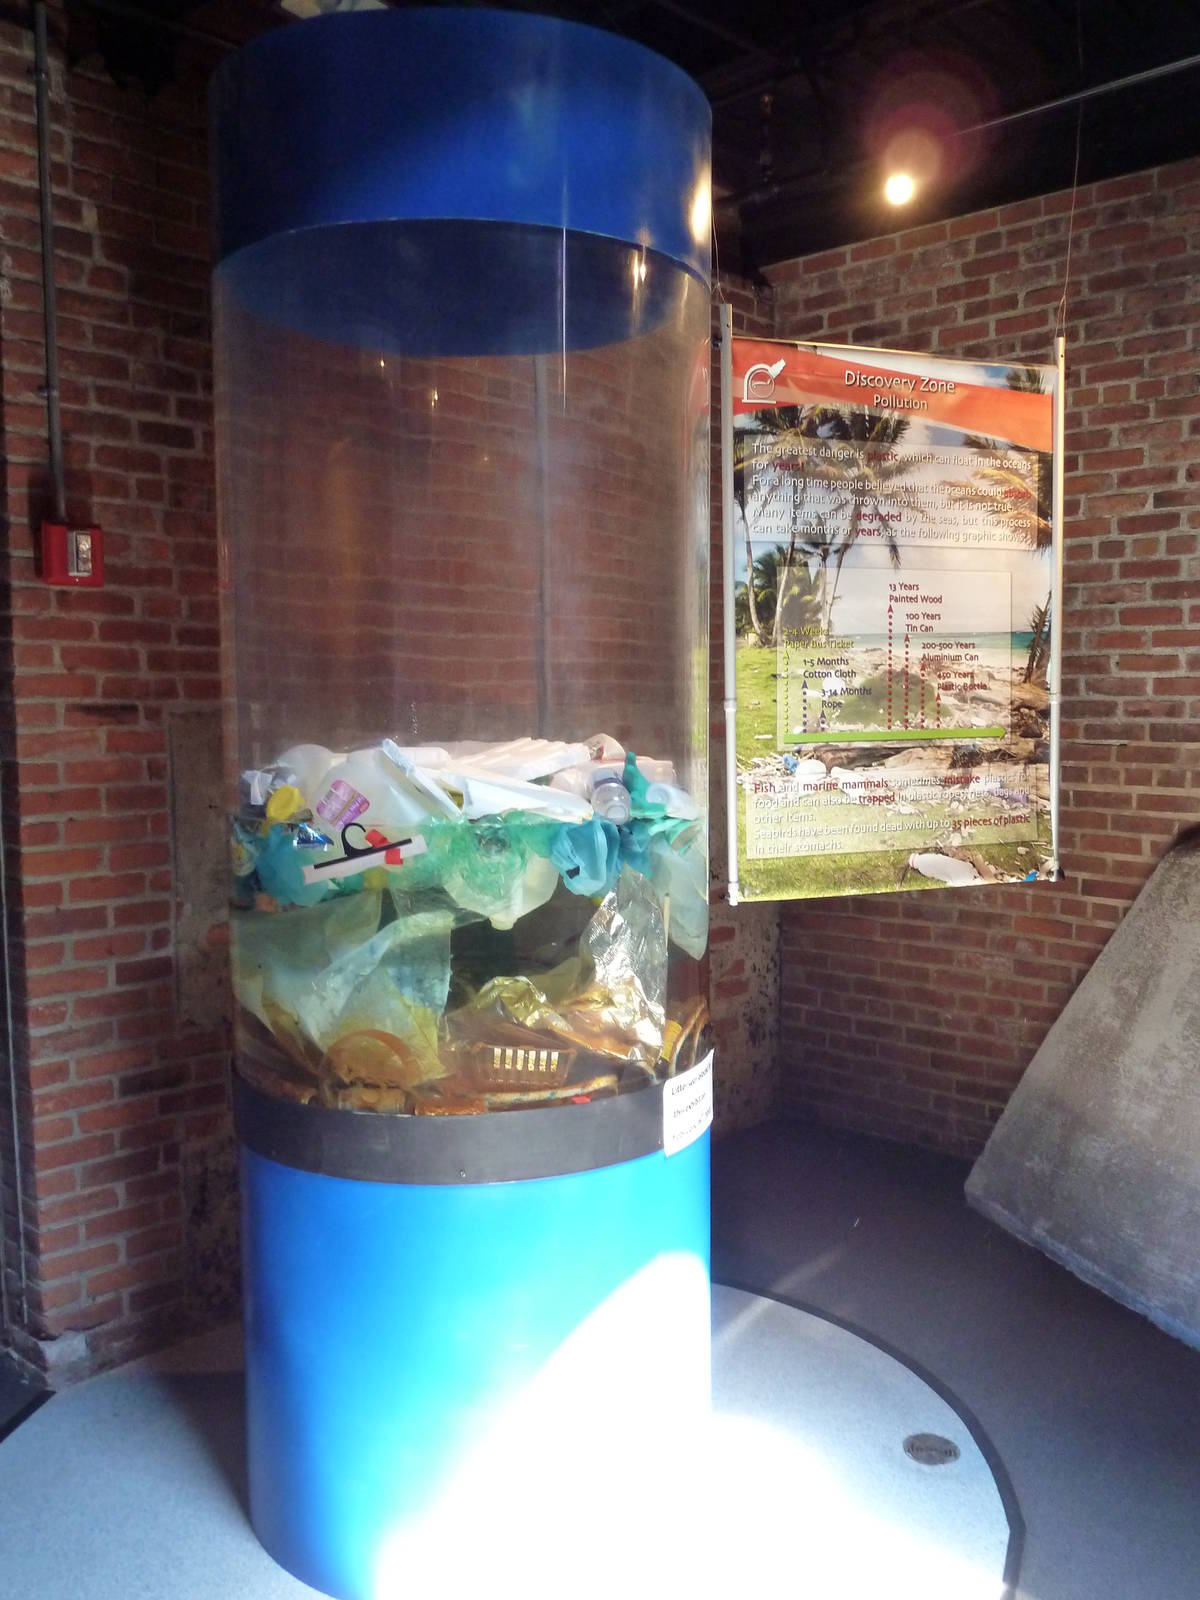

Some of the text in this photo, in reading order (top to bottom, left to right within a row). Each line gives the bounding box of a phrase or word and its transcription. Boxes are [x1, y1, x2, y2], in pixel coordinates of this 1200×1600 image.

[845, 370, 956, 393] Discovery Zone
[874, 394, 928, 410] Pollution
[752, 443, 773, 454] The
[776, 445, 817, 457] greatest
[820, 447, 853, 460] danger
[856, 448, 864, 459] is
[905, 452, 933, 463] which
[936, 456, 950, 464] can
[953, 455, 974, 466] float
[976, 456, 985, 466] in
[987, 457, 1001, 467] the
[1003, 460, 1031, 470] oceans
[752, 459, 804, 472] for years!
[752, 475, 772, 486] For
[773, 478, 780, 486] a
[782, 475, 804, 488] long
[806, 477, 829, 487] time
[831, 480, 863, 491] people
[865, 479, 909, 492] believed
[912, 483, 929, 493] that
[931, 484, 945, 494] the
[947, 486, 976, 496] oceans
[978, 486, 1001, 497] could
[752, 492, 800, 504] anything
[804, 493, 825, 503] that
[828, 495, 846, 504] was
[850, 494, 885, 505] thrown
[888, 496, 909, 507] into
[911, 498, 938, 509] them,
[941, 499, 954, 509] but
[975, 502, 991, 512] not
[753, 507, 785, 520] Many
[820, 511, 838, 520] can
[841, 510, 852, 520] be
[857, 511, 902, 523] degraded
[906, 513, 918, 525] by
[921, 513, 936, 524] the
[939, 516, 959, 526] seas,
[963, 515, 978, 525] but
[982, 516, 999, 527] this
[1001, 518, 1031, 529] process
[752, 524, 772, 534] can
[776, 523, 798, 534] take
[801, 524, 839, 535] months
[842, 527, 852, 535] or
[886, 529, 897, 538] as
[900, 527, 916, 538] the
[920, 528, 960, 542] following
[962, 531, 997, 543] graphic
[889, 582, 919, 591] 13 Years
[889, 595, 942, 603] Painted Wood
[921, 612, 941, 620] Years
[906, 624, 933, 632] Tin Can
[785, 640, 854, 650] Paper Bus Ticket
[922, 641, 975, 650] 200-500 Years
[803, 657, 849, 667] 1-5 Months
[922, 653, 979, 661] Aluminium Can
[803, 669, 856, 678] Cotton Cloth
[953, 671, 974, 679] Years
[840, 686, 872, 695] Months
[938, 682, 987, 691] Plastic Bottle
[821, 700, 843, 709] Rope
[754, 782, 775, 794] Fish
[778, 781, 799, 792] and
[803, 781, 838, 791] marine
[842, 778, 888, 789] mammals
[890, 777, 940, 787] sometimes
[944, 774, 980, 785] mistake
[755, 796, 778, 808] food
[781, 796, 800, 807] and
[803, 797, 820, 806] can
[823, 795, 843, 806] also
[859, 792, 895, 805] trapped
[898, 792, 906, 802] in
[909, 790, 937, 801] plastic
[755, 812, 783, 824] other
[754, 814, 1031, 840] Seabirds have been found dead with up to 35 pieces of plastic
[756, 843, 764, 854] in
[767, 842, 792, 854] their
